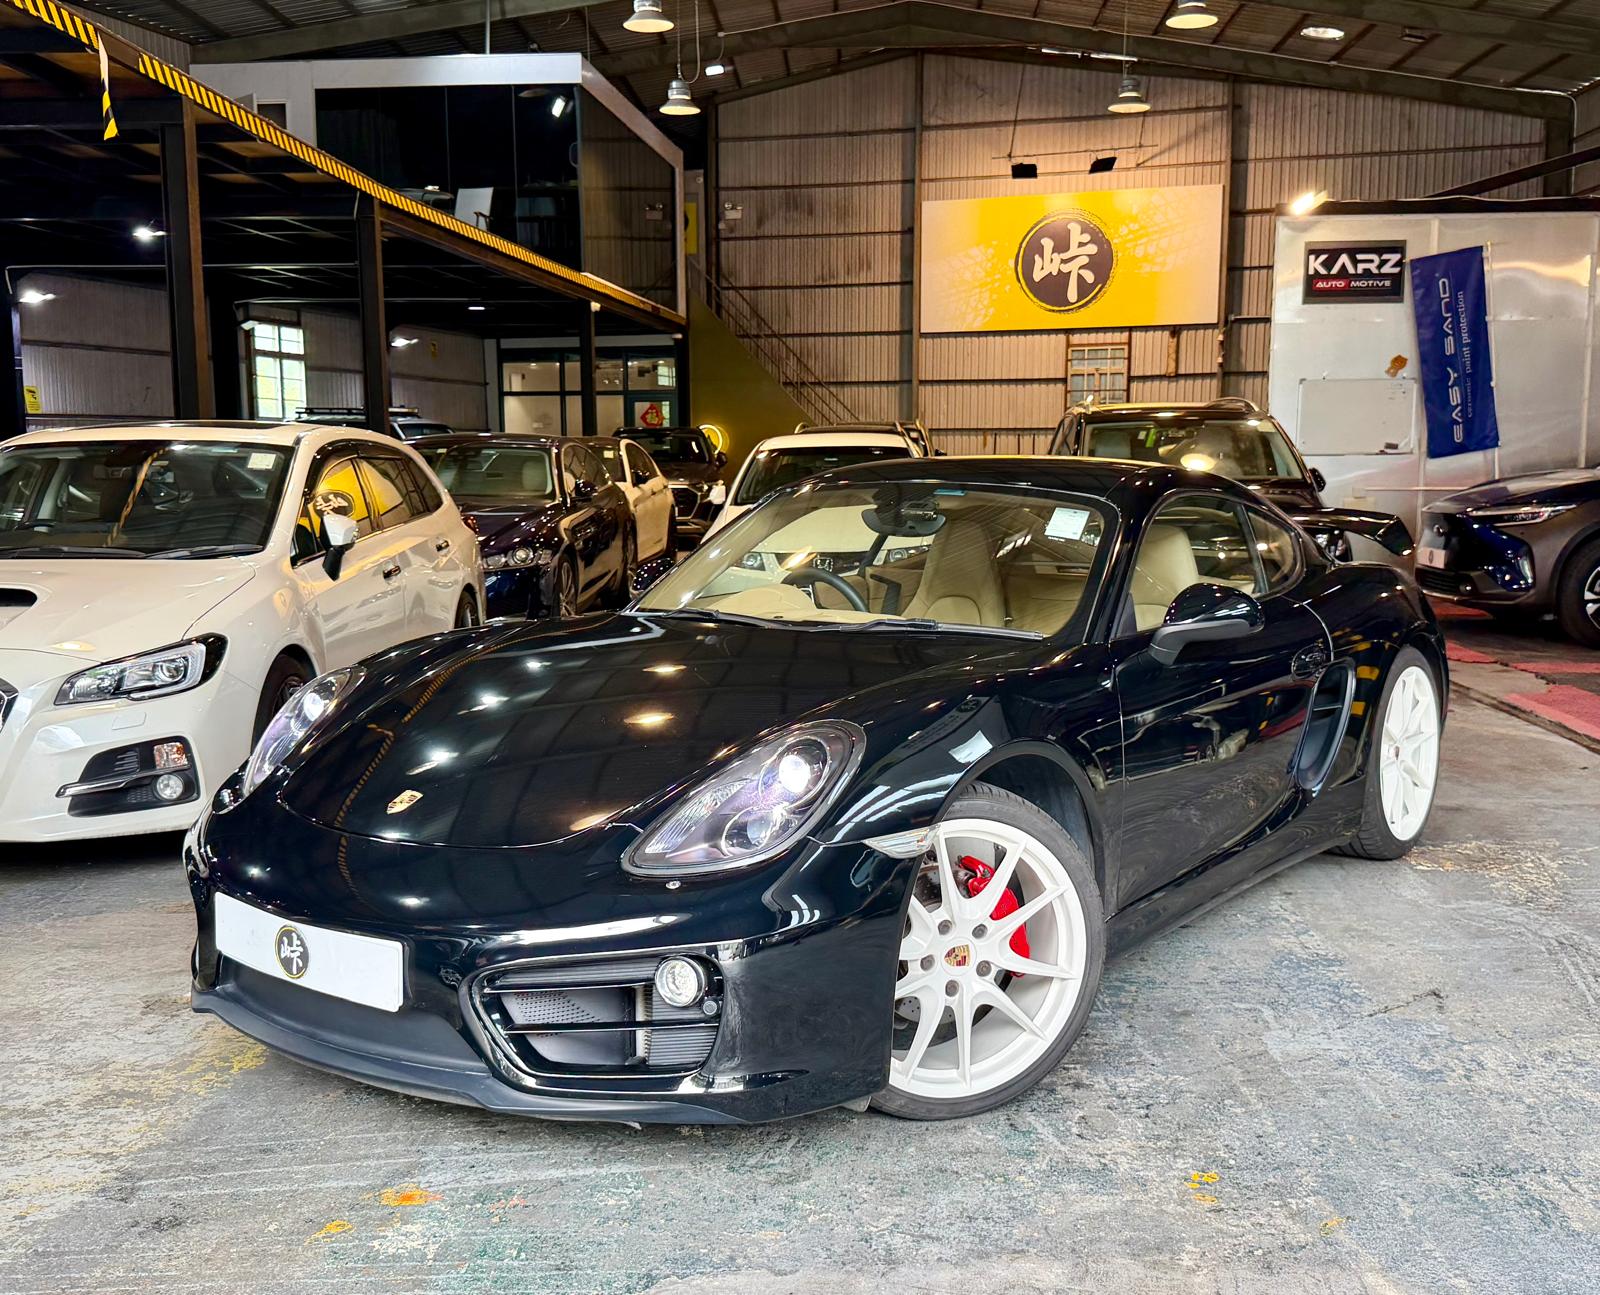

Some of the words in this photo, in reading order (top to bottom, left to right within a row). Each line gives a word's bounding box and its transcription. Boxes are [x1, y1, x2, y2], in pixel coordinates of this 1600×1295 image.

[1033, 222, 1098, 303] 峠
[1307, 252, 1402, 275] KARZ
[1315, 280, 1346, 288] AUTO
[1438, 278, 1455, 356] SAND
[1456, 291, 1471, 344] protection
[1462, 347, 1473, 374] paint
[1446, 367, 1464, 443] EASY
[280, 932, 304, 975] 峠
